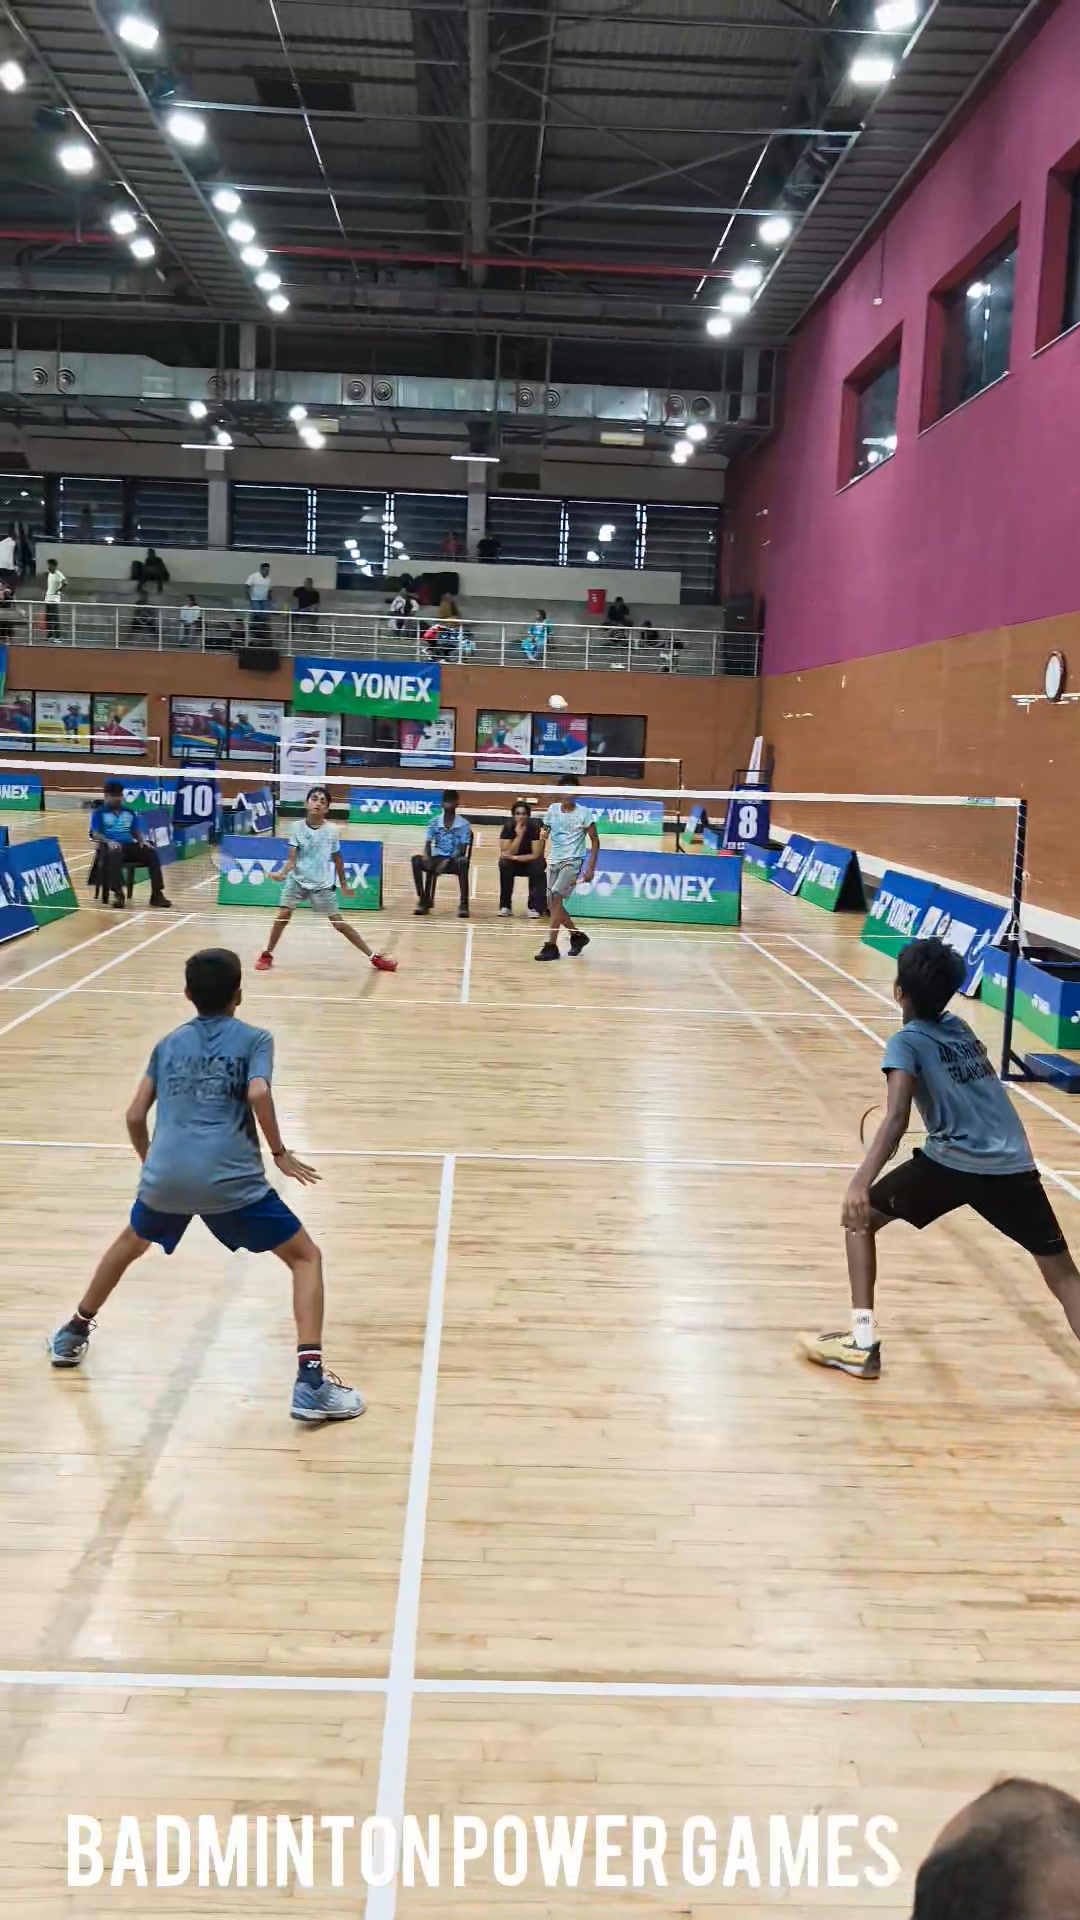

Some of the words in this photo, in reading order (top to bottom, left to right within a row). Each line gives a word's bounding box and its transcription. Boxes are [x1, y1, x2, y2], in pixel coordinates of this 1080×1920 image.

[351, 671, 433, 703] YONEX
[0, 784, 30, 800] NEX
[178, 785, 213, 817] 10
[388, 799, 434, 815] YONEX
[606, 808, 652, 824] YONEX
[738, 805, 758, 839] 8
[36, 860, 71, 897] YONEX
[630, 872, 717, 903] YONEX
[885, 895, 923, 937] YONEX
